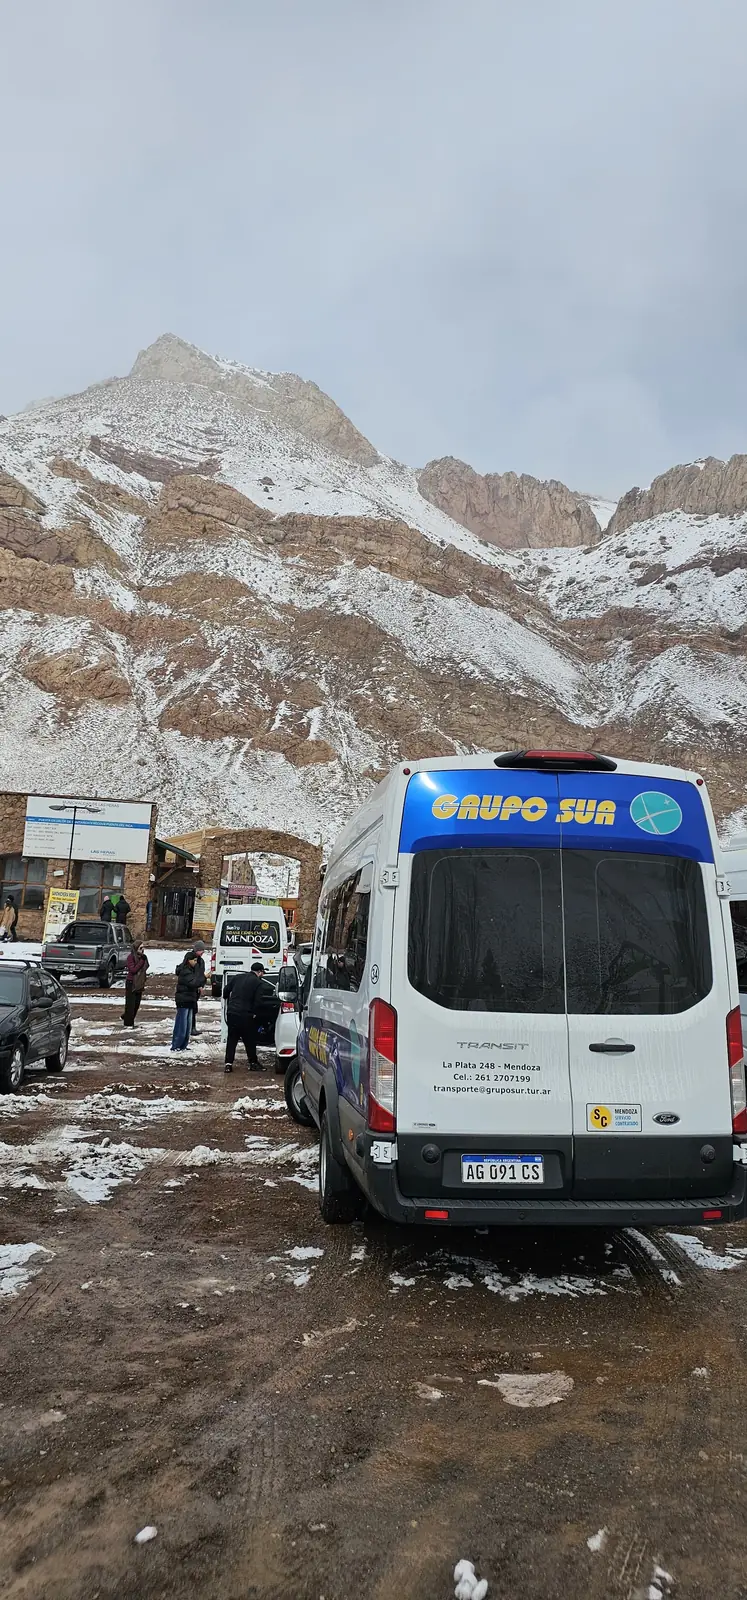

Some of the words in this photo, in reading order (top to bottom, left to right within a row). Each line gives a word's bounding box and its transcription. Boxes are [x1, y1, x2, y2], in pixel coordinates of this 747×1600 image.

[431, 794, 548, 822] GRUPO
[555, 798, 617, 826] SUR
[225, 934, 274, 943] MENDOZA
[456, 1041, 530, 1051] TRANSIT
[442, 1061, 453, 1069] La
[455, 1061, 477, 1070] Plata
[479, 1062, 496, 1070] 248
[503, 1063, 541, 1071] Mendoza
[453, 1073, 472, 1081] Cel.:
[475, 1073, 491, 1081] 261
[493, 1074, 531, 1083] 2707199
[433, 1084, 552, 1095] transporte@gruposur.tur.ar
[467, 1164, 484, 1180] AG
[489, 1164, 517, 1180] 091
[521, 1164, 540, 1180] CS
